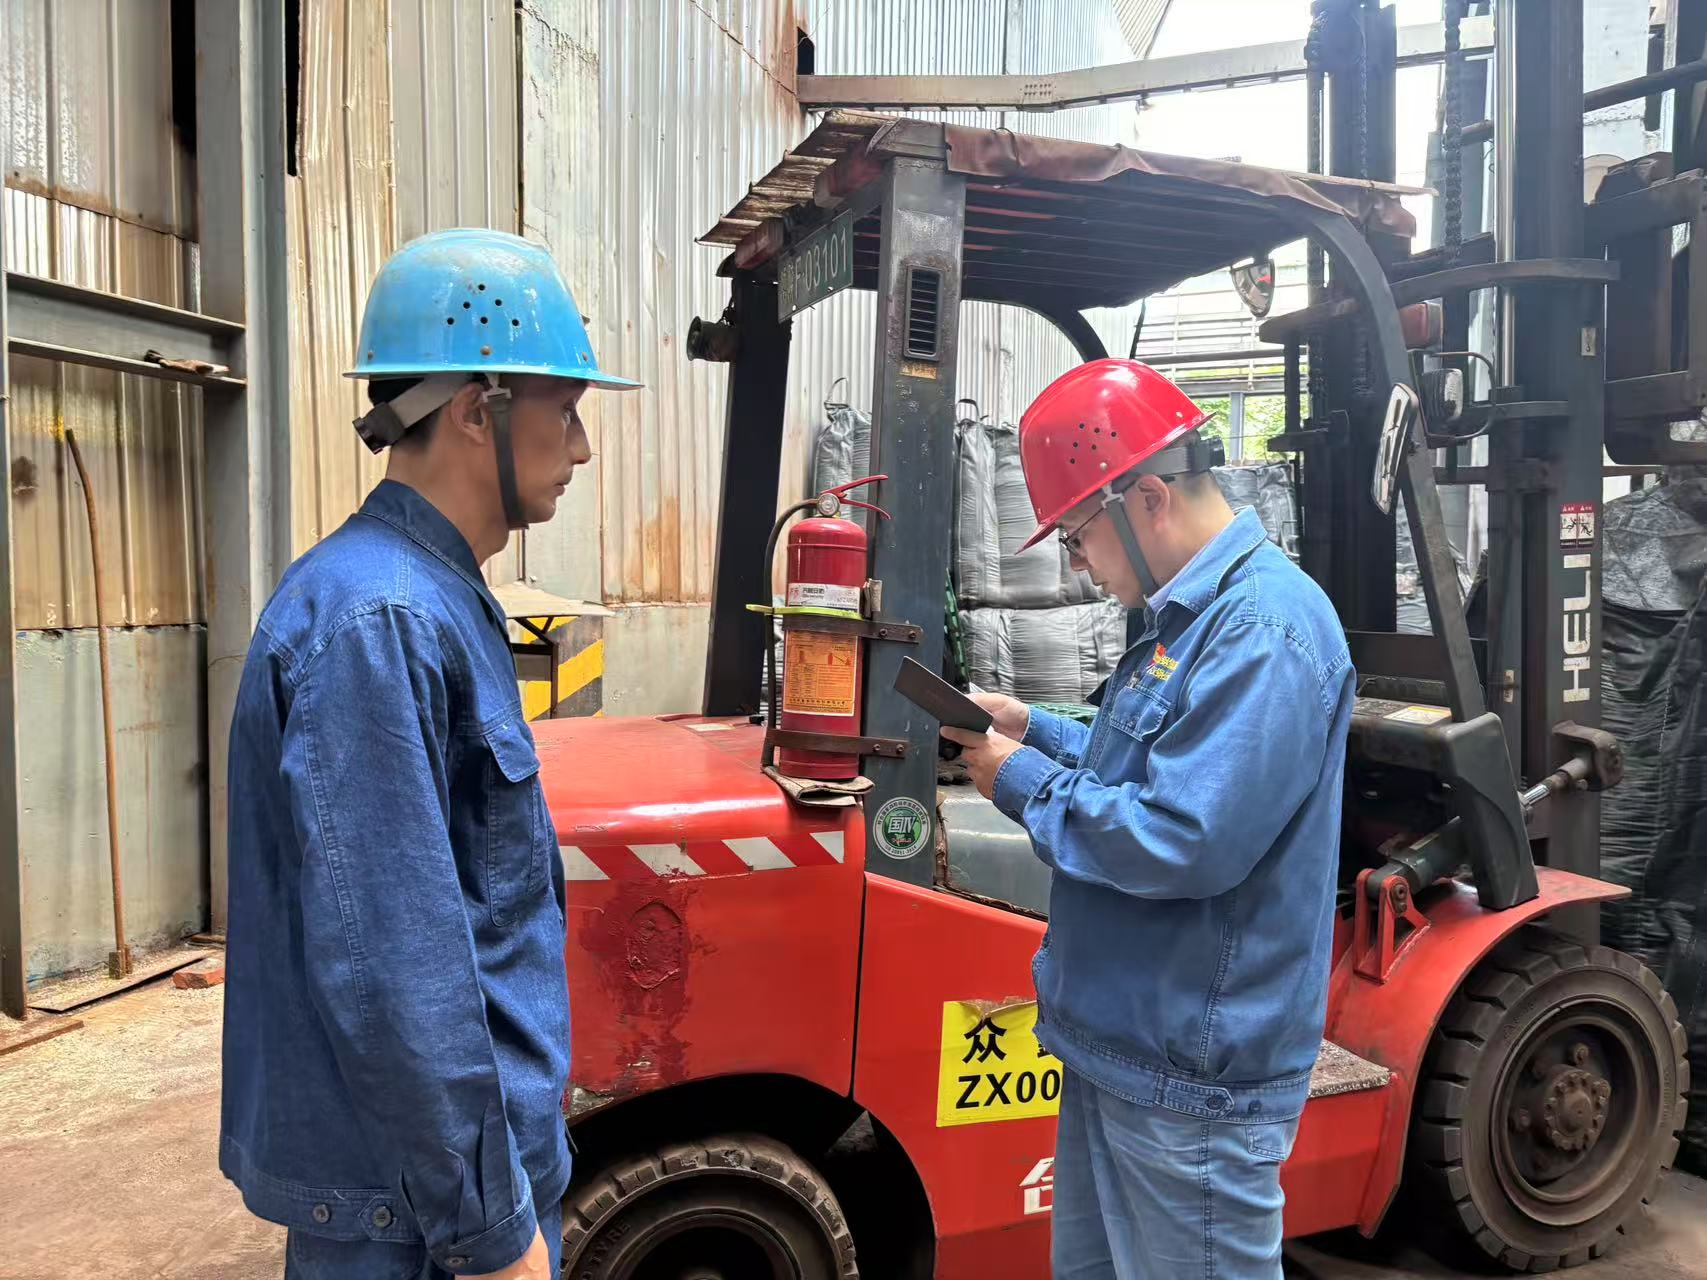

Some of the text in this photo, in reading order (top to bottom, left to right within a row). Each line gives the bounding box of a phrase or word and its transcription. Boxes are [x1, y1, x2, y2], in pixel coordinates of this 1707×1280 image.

[1563, 553, 1592, 703] HELI
[962, 1017, 1007, 1064] 众
[955, 1069, 1061, 1110] ZX00
